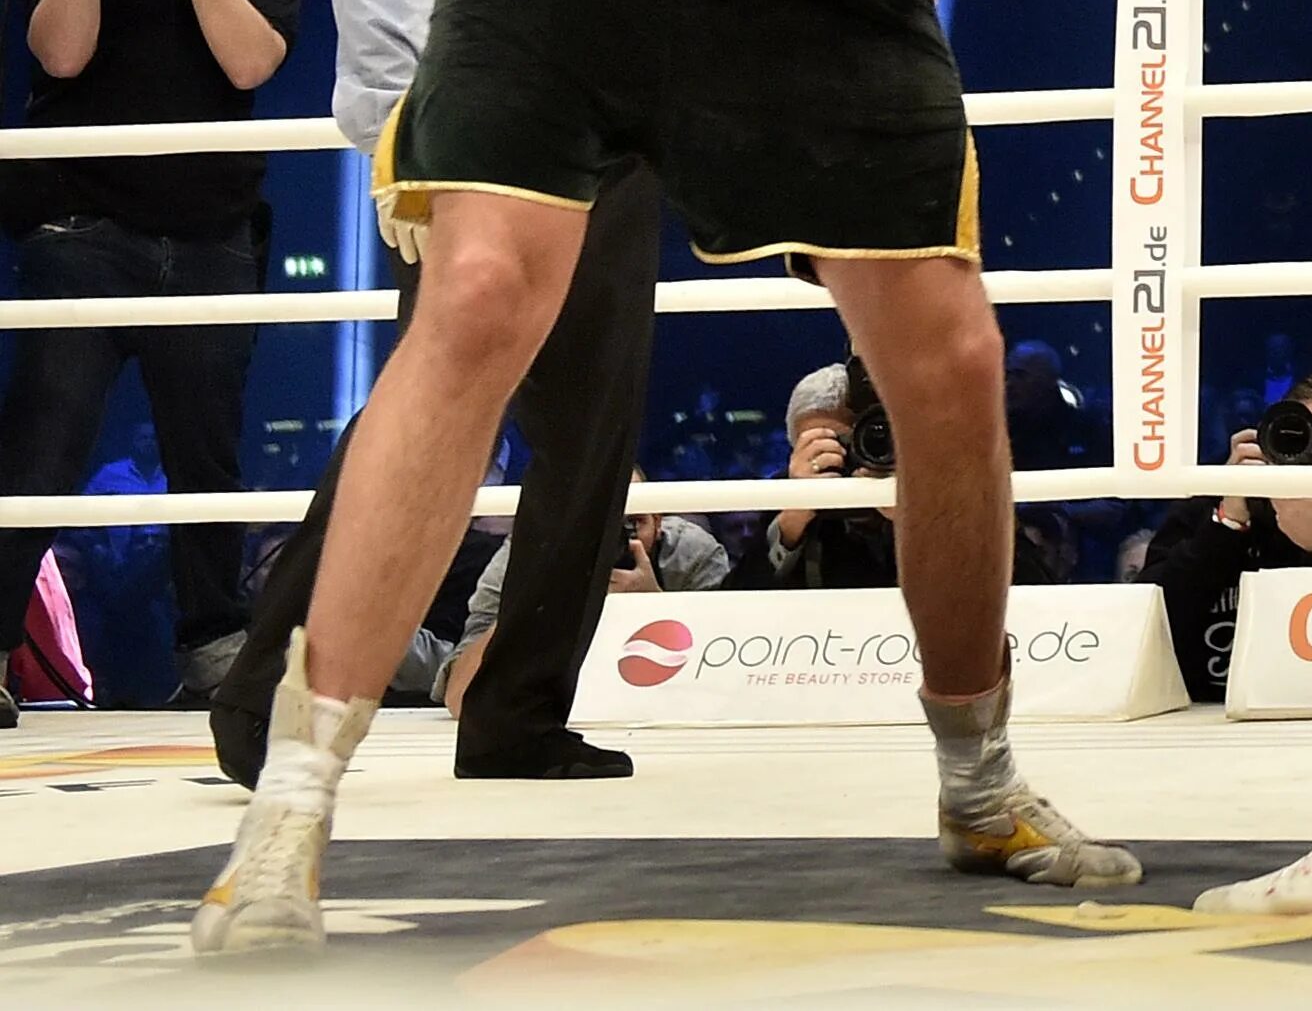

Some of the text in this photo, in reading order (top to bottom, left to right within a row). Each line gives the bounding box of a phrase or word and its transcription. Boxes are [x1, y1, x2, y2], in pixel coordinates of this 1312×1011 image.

[695, 621, 1100, 680] point-ro.de
[746, 671, 914, 686] THE BEAUTY STORE
